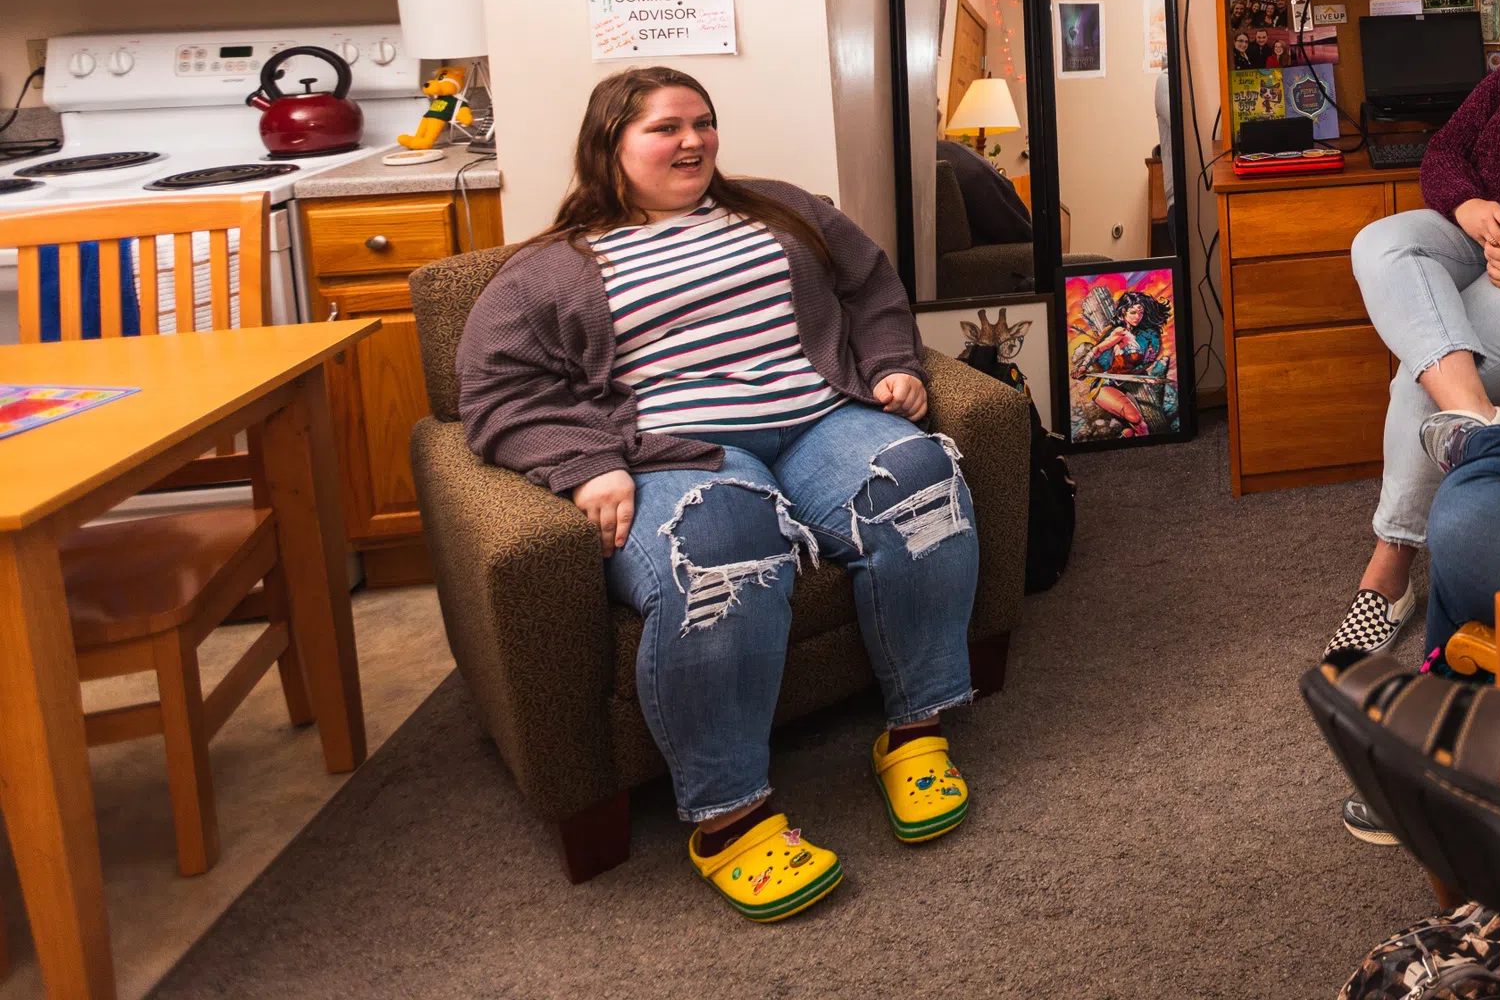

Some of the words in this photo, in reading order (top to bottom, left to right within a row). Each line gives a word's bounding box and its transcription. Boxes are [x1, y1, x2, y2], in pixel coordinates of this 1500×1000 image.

[628, 8, 697, 22] ADVISOR
[1315, 13, 1333, 21] LIVE
[1333, 12, 1345, 20] UP
[638, 27, 689, 41] STAFF!
